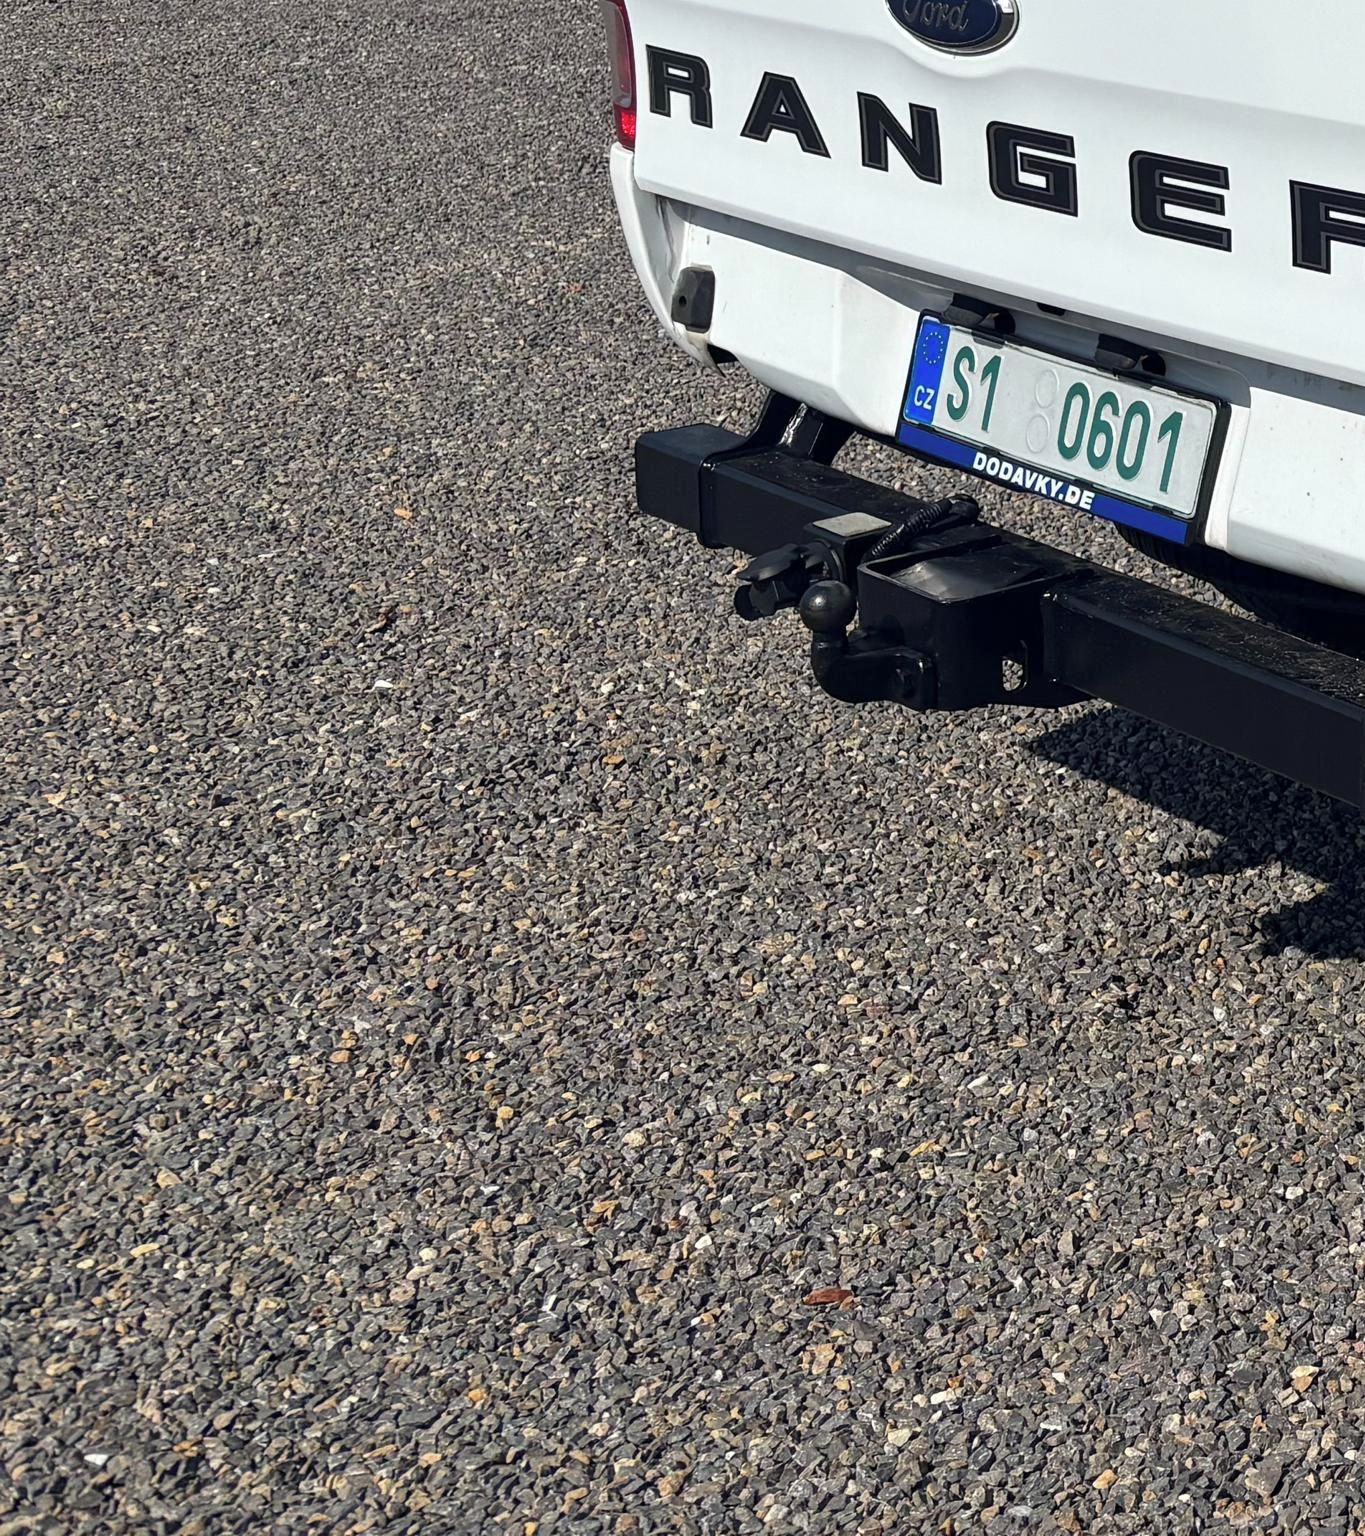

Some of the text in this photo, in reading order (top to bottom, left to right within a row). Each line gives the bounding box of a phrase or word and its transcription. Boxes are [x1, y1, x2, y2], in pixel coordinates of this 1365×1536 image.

[914, 384, 935, 411] CZ
[946, 345, 1184, 493] S1 0601
[972, 451, 1096, 511] DODAVKY.DE
